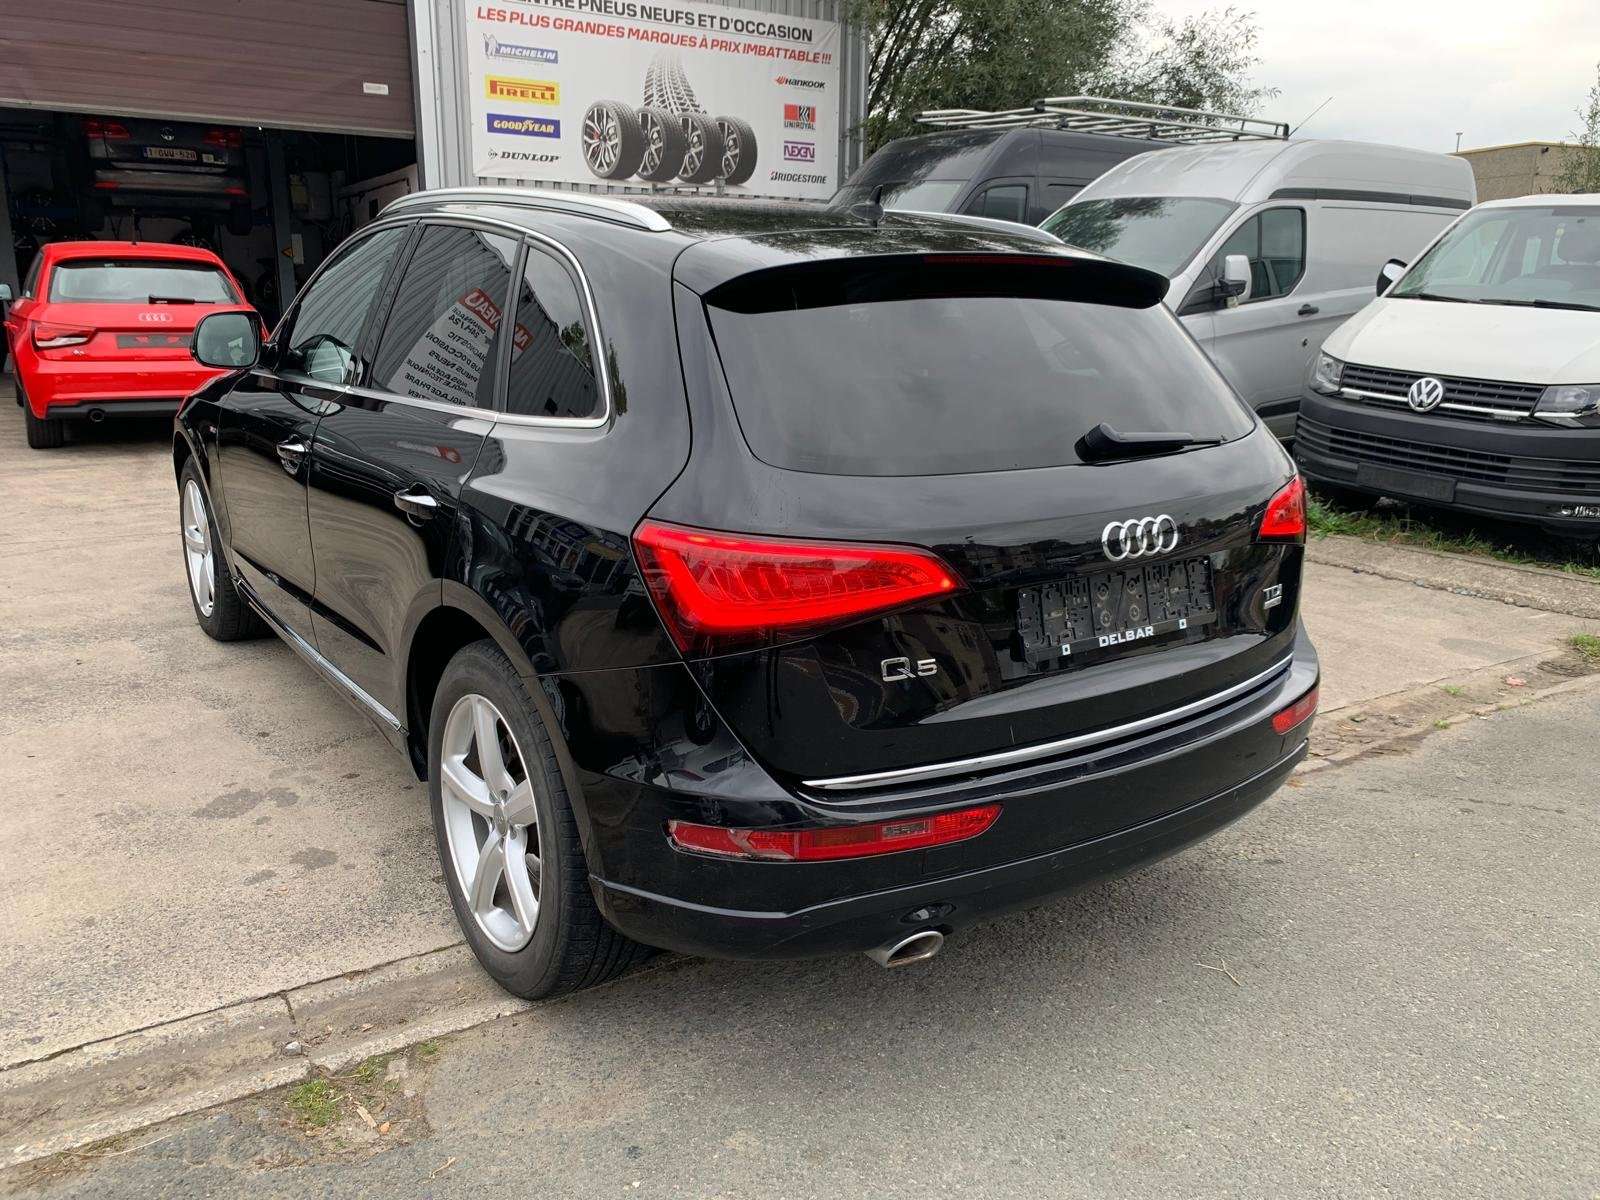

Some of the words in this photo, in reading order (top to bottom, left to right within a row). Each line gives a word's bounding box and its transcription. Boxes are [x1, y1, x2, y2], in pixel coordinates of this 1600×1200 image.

[579, 0, 637, 18] PNEUS
[641, 5, 695, 26] NEUFS
[698, 13, 717, 29] ET
[719, 17, 814, 42] D'OCCASION
[477, 6, 507, 22] LES
[509, 11, 550, 29] PLUS
[553, 17, 626, 38] GRANDES
[627, 27, 698, 48] MARQUES
[699, 34, 709, 49] À
[711, 39, 742, 54] PRIX
[500, 46, 557, 60] MICHELIN
[489, 79, 555, 101] PIRELLI
[493, 120, 555, 133] GOODYEAR
[784, 120, 816, 130] UNIROYAL
[500, 151, 560, 163] DUNLOP
[784, 145, 815, 158] NEXEN
[770, 171, 827, 184] BRIDGESTONE
[1099, 626, 1154, 648] DELBAR
[881, 657, 938, 682] Q5
